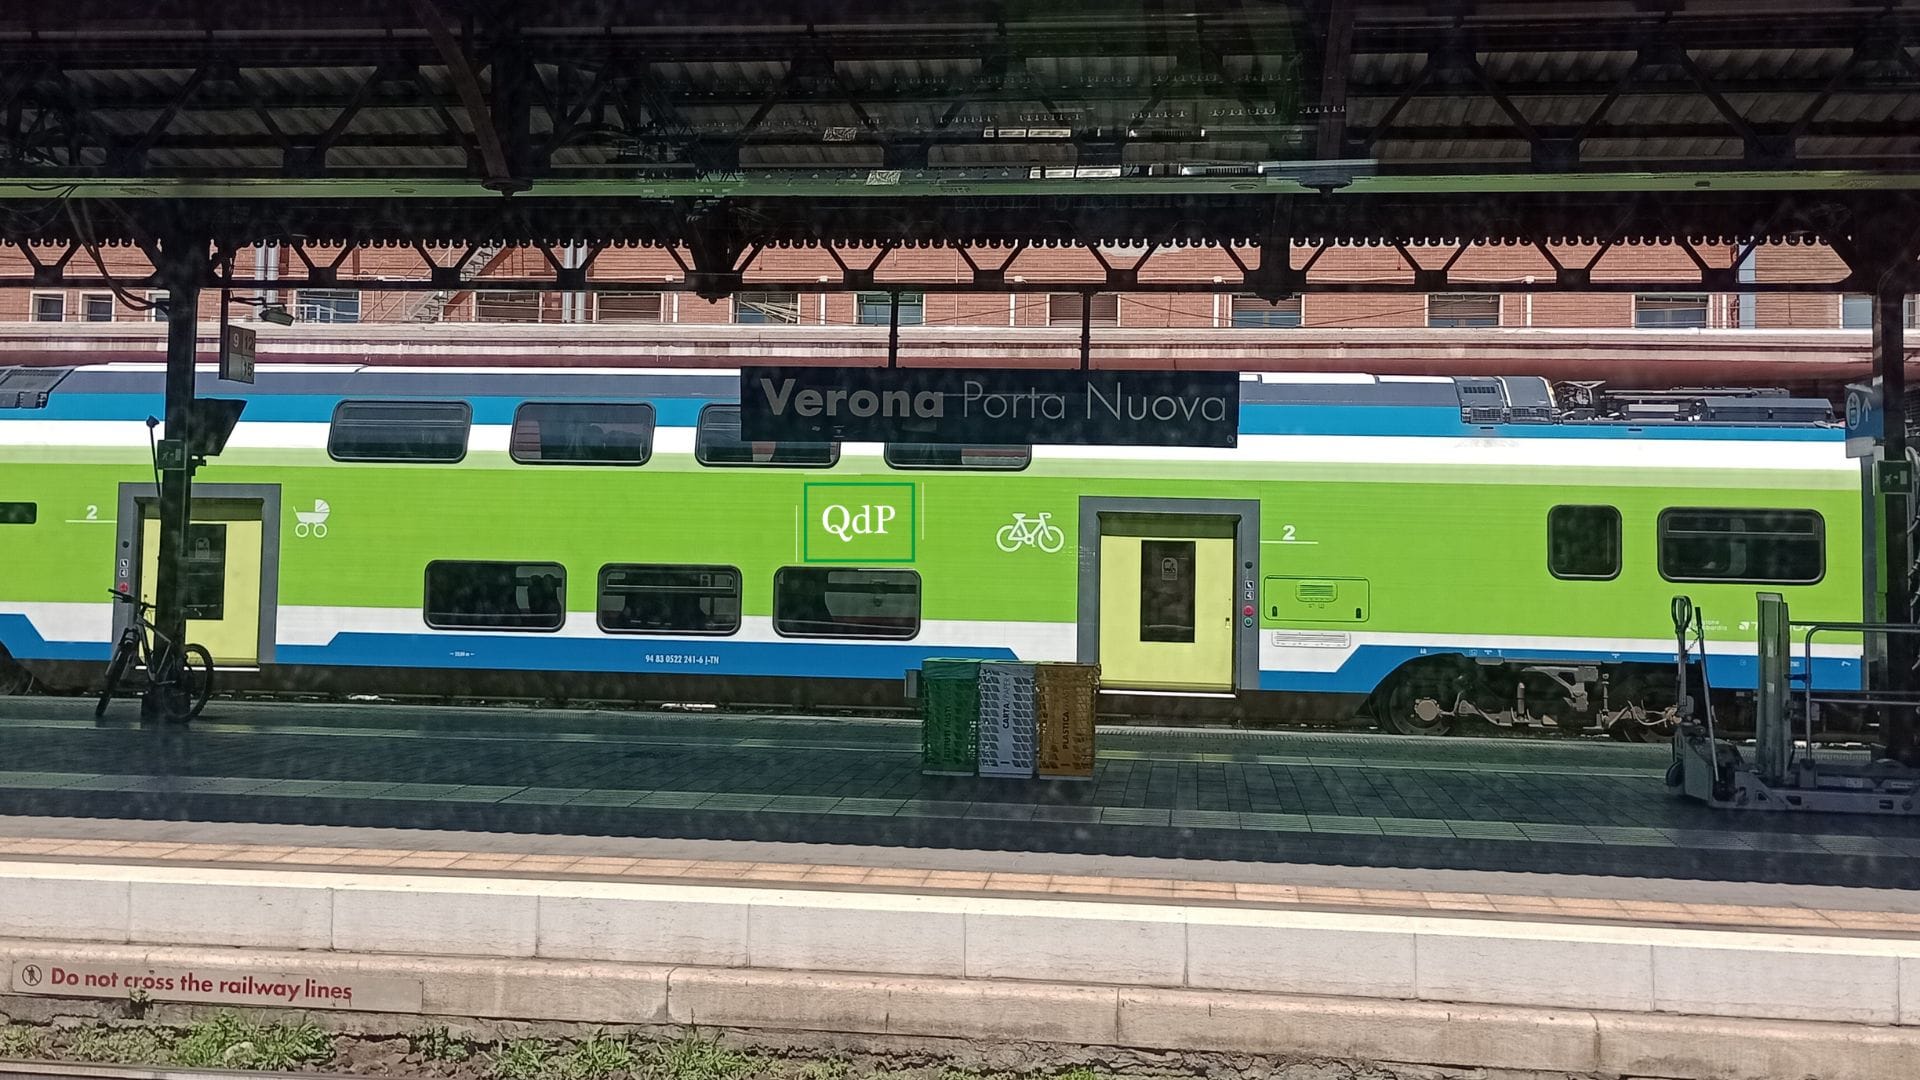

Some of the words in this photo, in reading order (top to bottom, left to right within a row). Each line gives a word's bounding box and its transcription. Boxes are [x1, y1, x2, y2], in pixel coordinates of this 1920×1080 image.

[233, 333, 239, 348] 9
[245, 335, 254, 350] 12
[243, 361, 252, 377] 15
[760, 378, 944, 418] Verona
[963, 380, 1066, 420] Porta
[1087, 381, 1226, 422] Nuova
[86, 504, 97, 520] 2
[1282, 525, 1296, 541] 2
[645, 654, 654, 663] 94
[655, 654, 664, 663] 83
[665, 654, 682, 664] 0522
[51, 967, 79, 986] Do
[85, 972, 118, 988] not
[124, 974, 174, 990] cross
[181, 972, 213, 992] the
[219, 975, 301, 1002] railway
[305, 978, 353, 1000] lines
